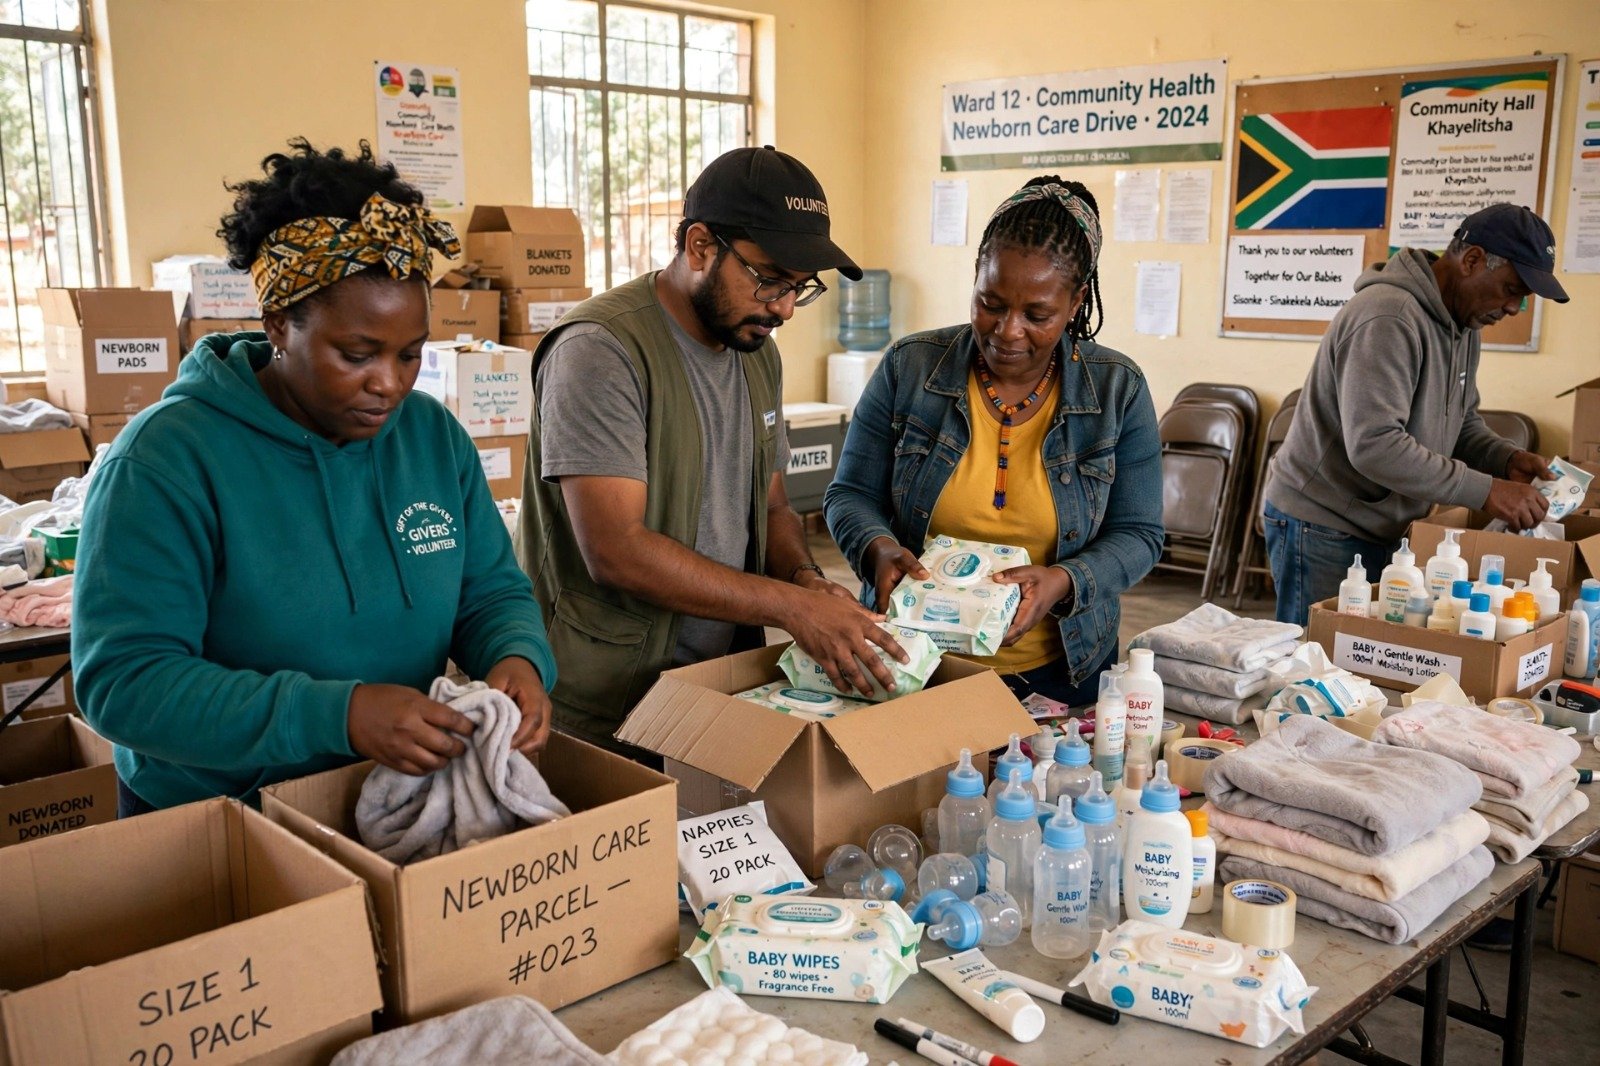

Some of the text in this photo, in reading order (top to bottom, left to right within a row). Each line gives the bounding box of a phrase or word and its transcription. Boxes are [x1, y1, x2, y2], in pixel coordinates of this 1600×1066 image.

[952, 91, 995, 113] Ward
[1001, 90, 1020, 110] 12
[1037, 80, 1143, 108] Community
[1149, 72, 1215, 99] Health
[1410, 95, 1535, 117] Community Hall
[952, 117, 1031, 141] Newborn
[1037, 115, 1079, 136] Care
[1085, 110, 1137, 133] Drive
[1156, 104, 1209, 129] 2024
[1427, 118, 1514, 137] Khayelitsha
[526, 249, 572, 260] BLANKETS
[1239, 245, 1354, 258] Thank you to our volunteers
[528, 265, 571, 275] DONATED
[1245, 270, 1342, 283] Together for Our Babies
[1233, 295, 1262, 305] Sisonke
[101, 343, 160, 354] NEWBORN
[118, 357, 147, 368] PADS
[474, 373, 519, 383] BLANKETS
[791, 450, 828, 468] WATER
[396, 502, 454, 533] GIFT OF THE GIVERS
[408, 523, 450, 542] GIVERS
[411, 538, 457, 555] VOLUNTEER
[1352, 641, 1376, 653] BABY
[1384, 648, 1413, 661] Gentle
[1416, 655, 1440, 667] Wash
[1128, 700, 1153, 710] BABY
[8, 794, 93, 826] NEWBORN
[18, 814, 86, 840] DONATED
[681, 813, 754, 843] NAPPIES
[699, 832, 757, 860] SIZE 1
[1144, 852, 1172, 864] BABY
[442, 818, 651, 920] NEWBORN CARE
[709, 853, 776, 884] 20 PACK
[1057, 890, 1082, 901] BABY
[500, 883, 599, 944] PARCEL
[1046, 903, 1070, 913] Gentle
[508, 926, 598, 986] #023
[748, 951, 840, 970] BABY WIPES
[773, 970, 820, 982] 80 wipes
[138, 957, 260, 1026] SIZE 1
[759, 980, 834, 994] Fragrance Free
[1164, 1007, 1189, 1019] 100ml
[190, 1005, 272, 1060] PACK
